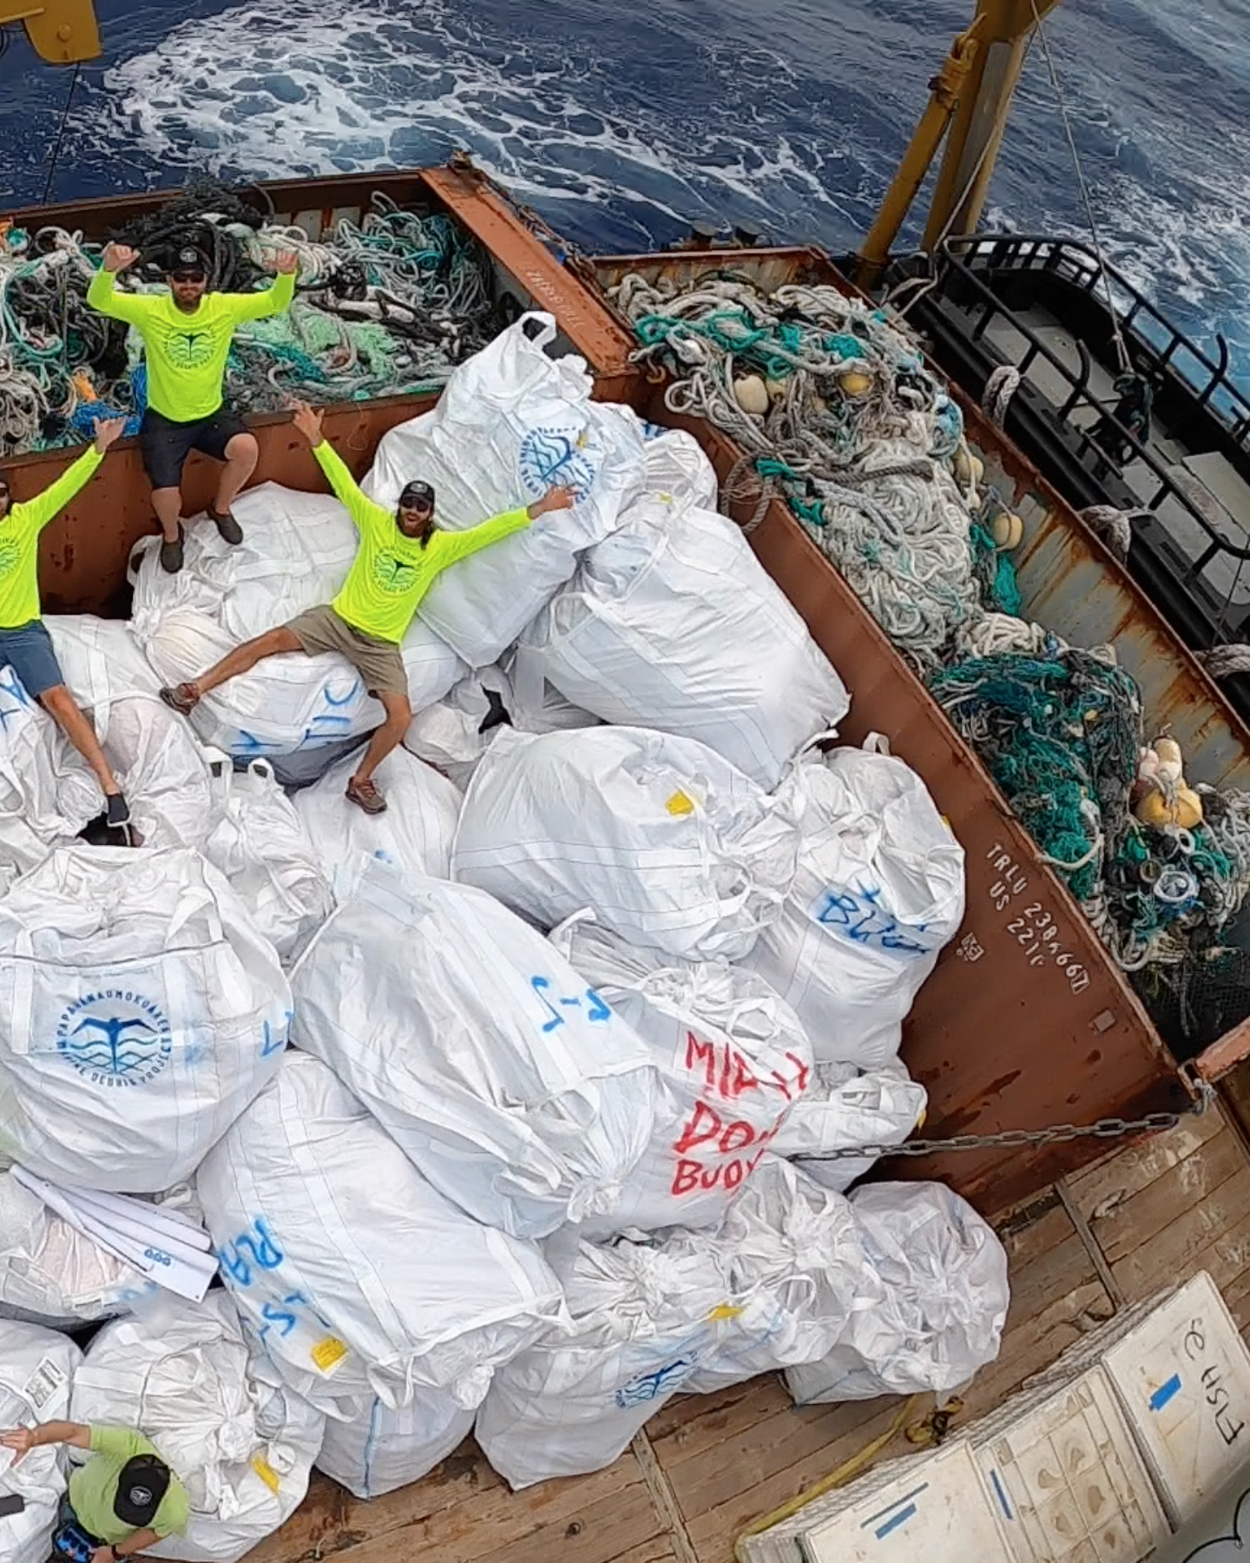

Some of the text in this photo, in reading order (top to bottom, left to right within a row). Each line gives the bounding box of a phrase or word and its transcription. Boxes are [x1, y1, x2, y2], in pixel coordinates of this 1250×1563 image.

[986, 842, 1029, 895] TRLU
[989, 880, 1011, 912] US
[1200, 1364, 1246, 1446] FISH
